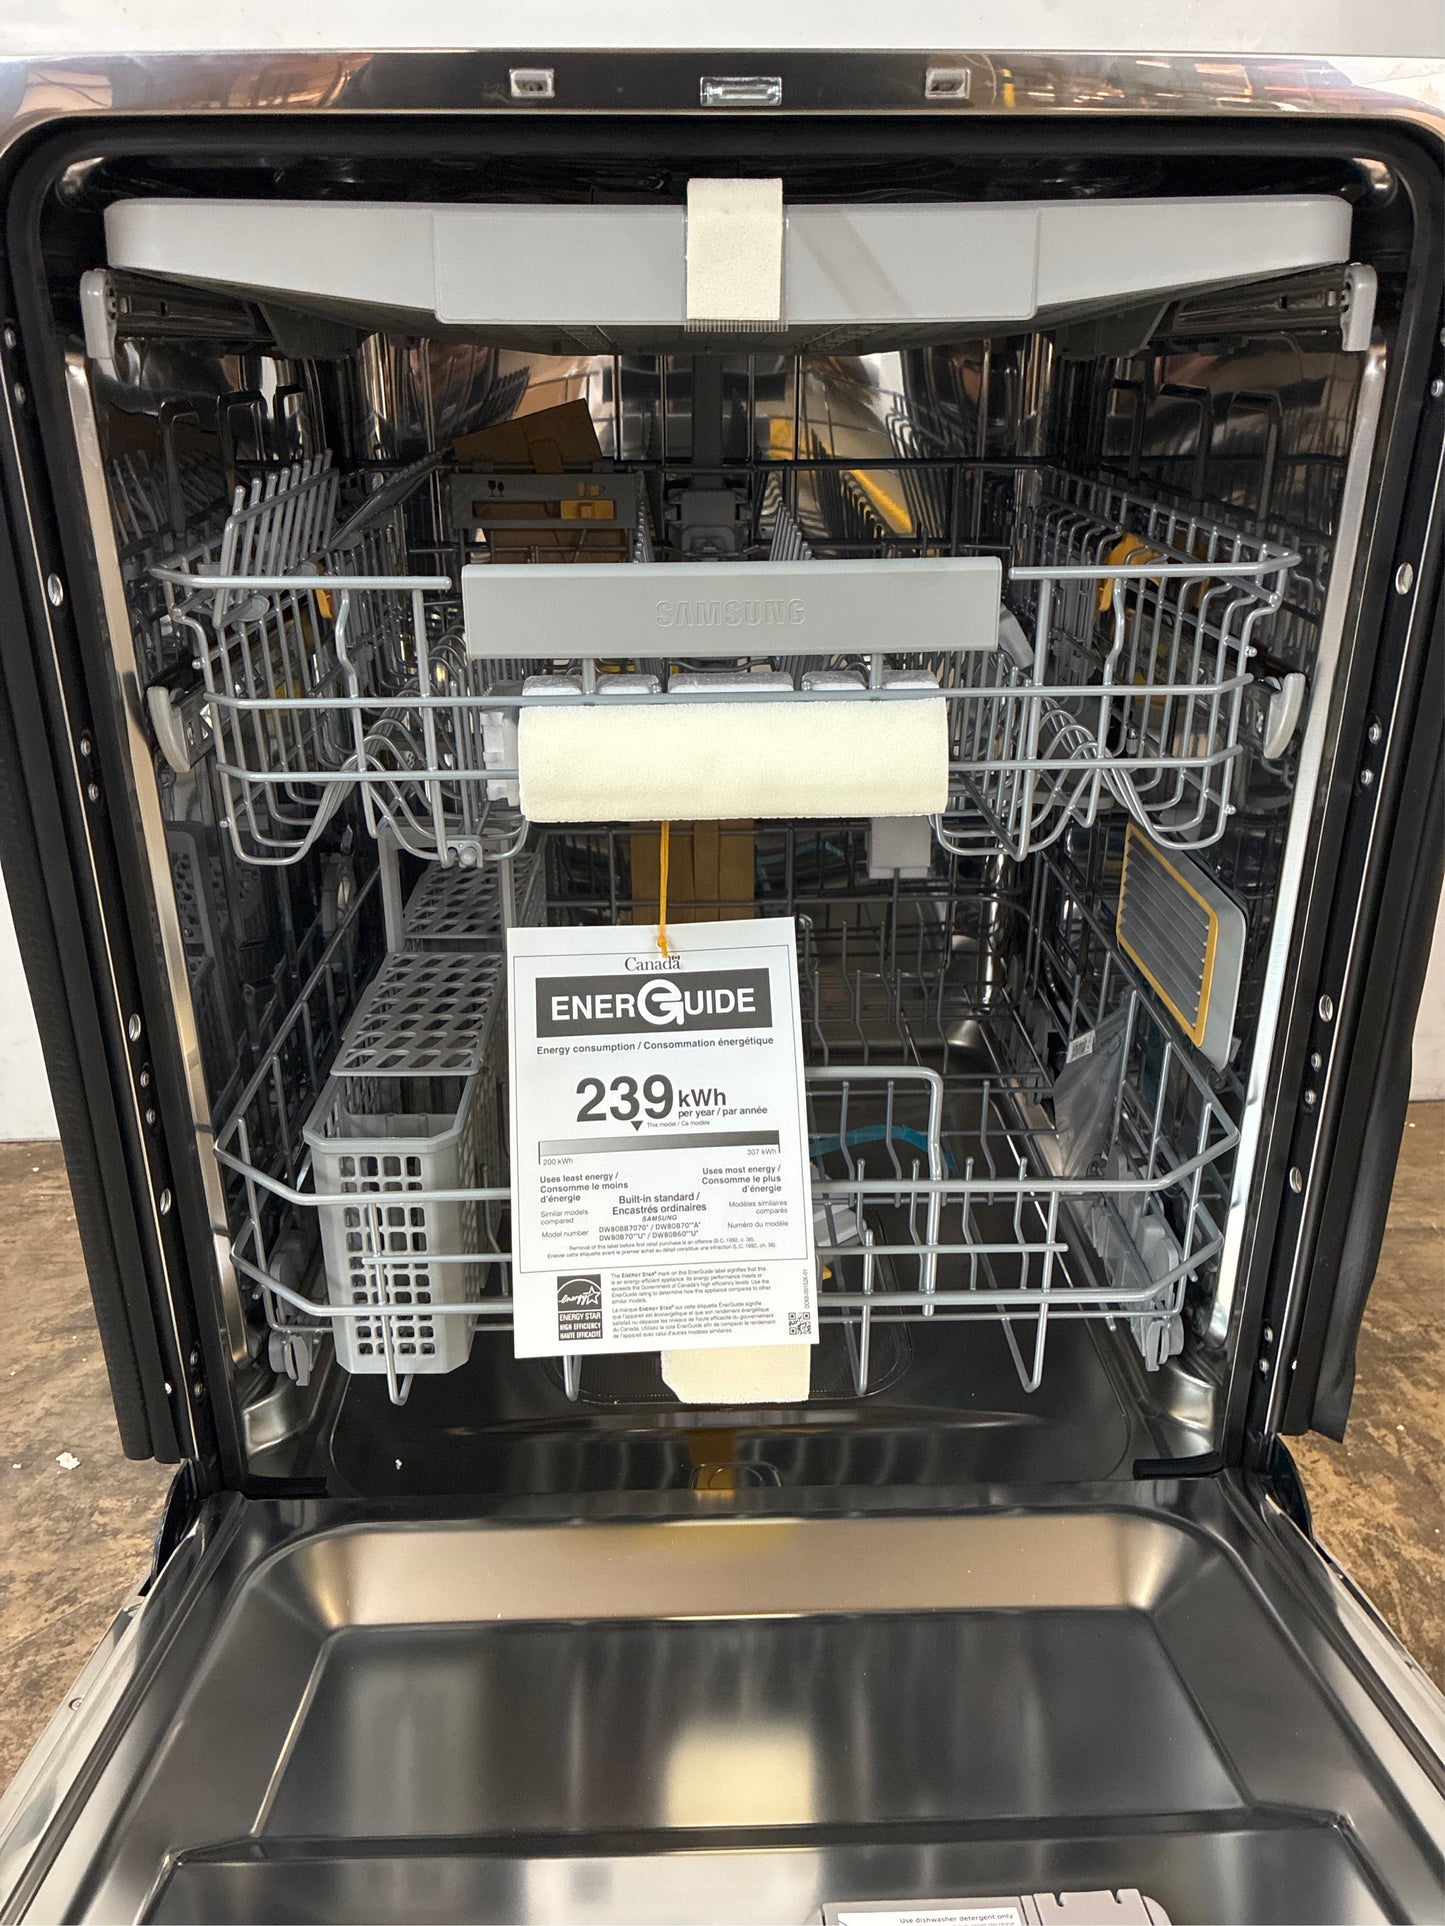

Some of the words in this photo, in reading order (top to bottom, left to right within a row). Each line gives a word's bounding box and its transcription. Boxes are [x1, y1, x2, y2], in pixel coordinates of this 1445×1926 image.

[656, 598, 806, 628] SAMSUNG
[624, 956, 680, 972] Canada
[537, 1046, 570, 1056] Energy
[573, 1043, 635, 1053] consumption
[644, 1039, 715, 1050] Consommation
[718, 1037, 774, 1047] énergétique
[576, 1074, 674, 1122] 239
[679, 1088, 726, 1107] kWh
[679, 1110, 693, 1121] per
[695, 1109, 715, 1119] year
[723, 1109, 738, 1117] par
[740, 1107, 768, 1115] année
[703, 1167, 723, 1177] Uses
[725, 1166, 746, 1174] most
[540, 1176, 560, 1184] Uses
[563, 1174, 583, 1182] least
[702, 1177, 750, 1185] Consomme
[763, 1175, 781, 1184] plus
[540, 1185, 590, 1194] Consomme
[602, 1182, 628, 1190] moins
[742, 1185, 782, 1194] d'énergie
[541, 1194, 581, 1203] d'énergie
[619, 1195, 652, 1204] Built-in
[654, 1192, 694, 1203] standard
[541, 1210, 563, 1218] Similar
[613, 1205, 658, 1215] Encastrés
[661, 1203, 707, 1213] ordinaires
[756, 1207, 788, 1215] comparés
[541, 1217, 574, 1226] compared
[642, 1214, 677, 1222] SAMSUNG
[560, 1313, 584, 1322] ENERGY
[585, 1312, 601, 1320] STAR
[960, 1914, 994, 1922] detergent
